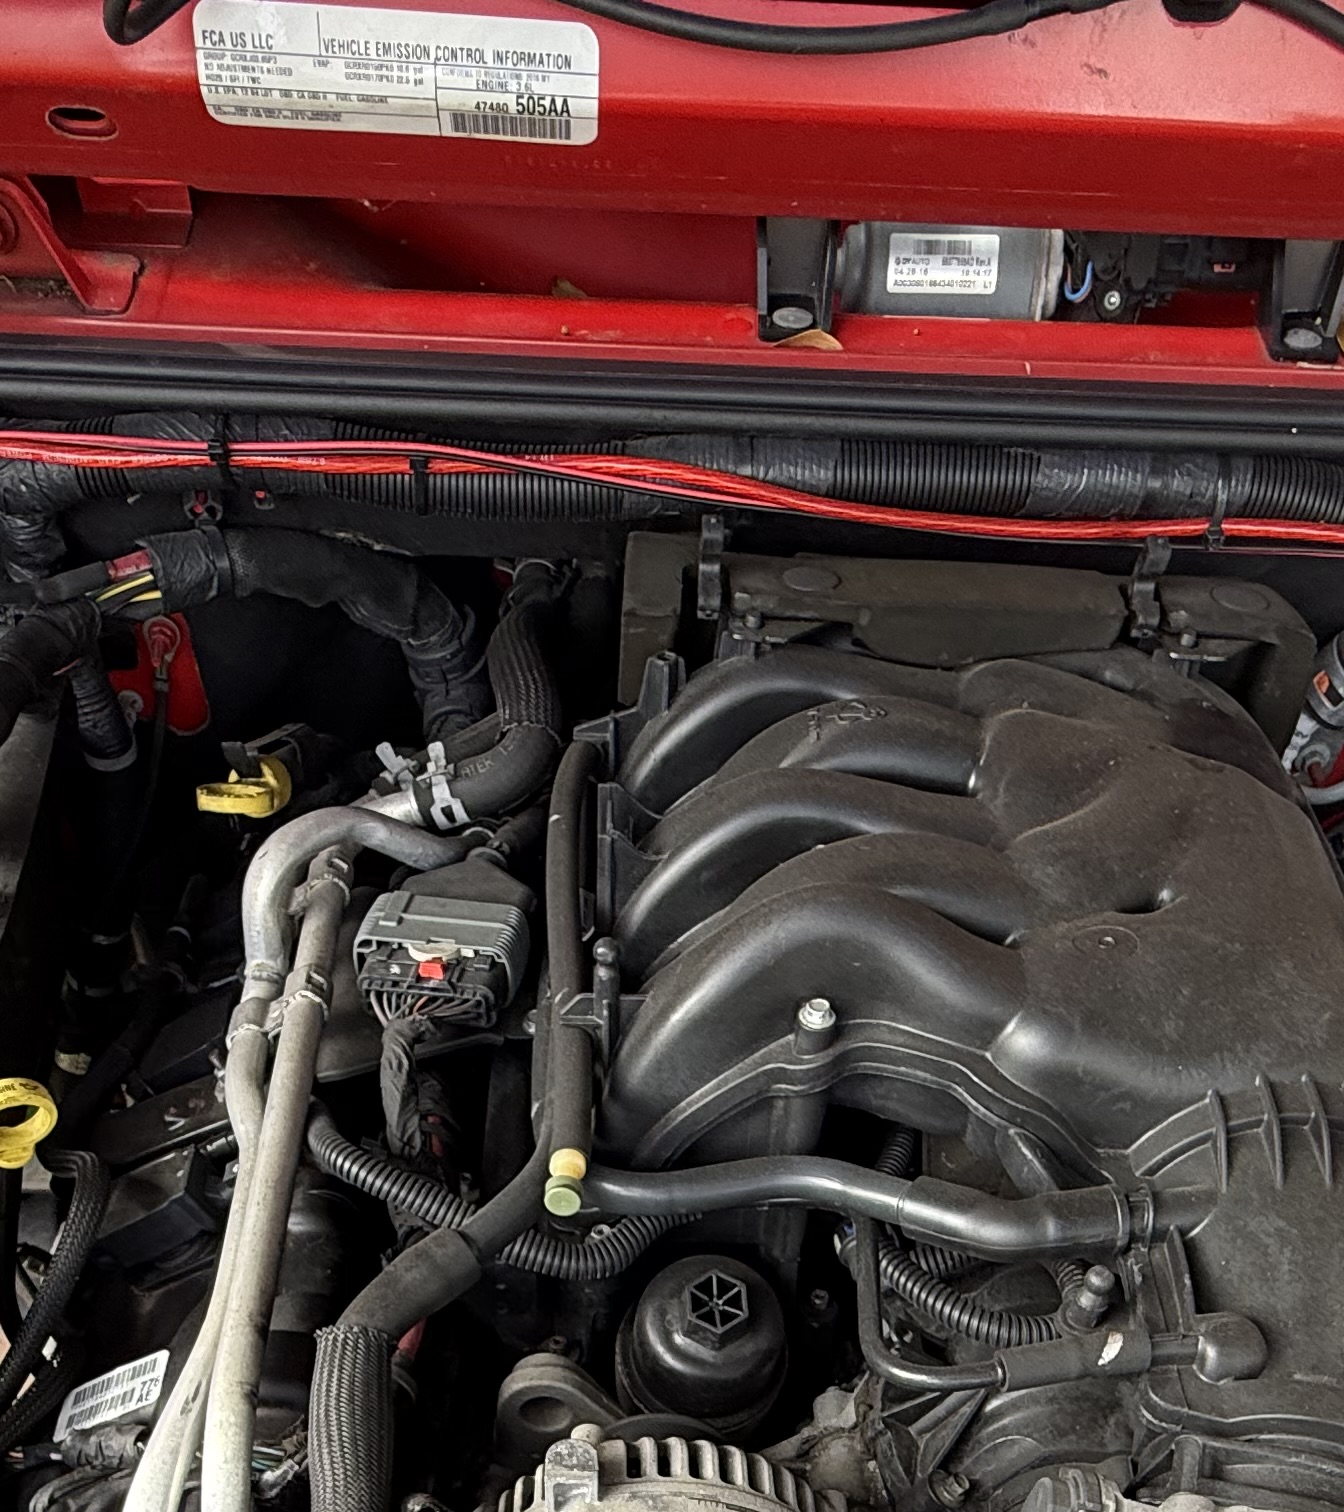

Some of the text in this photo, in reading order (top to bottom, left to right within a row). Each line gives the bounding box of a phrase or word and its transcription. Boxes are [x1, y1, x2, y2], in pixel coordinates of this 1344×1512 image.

[202, 30, 273, 50] FCA US LLC
[323, 38, 572, 70] VEHICLE EMISSION CONTROL INFORMATION
[476, 80, 534, 93] ENGINE: 3.6L
[475, 95, 571, 117] 47480 505AA
[136, 1390, 152, 1405] AE
